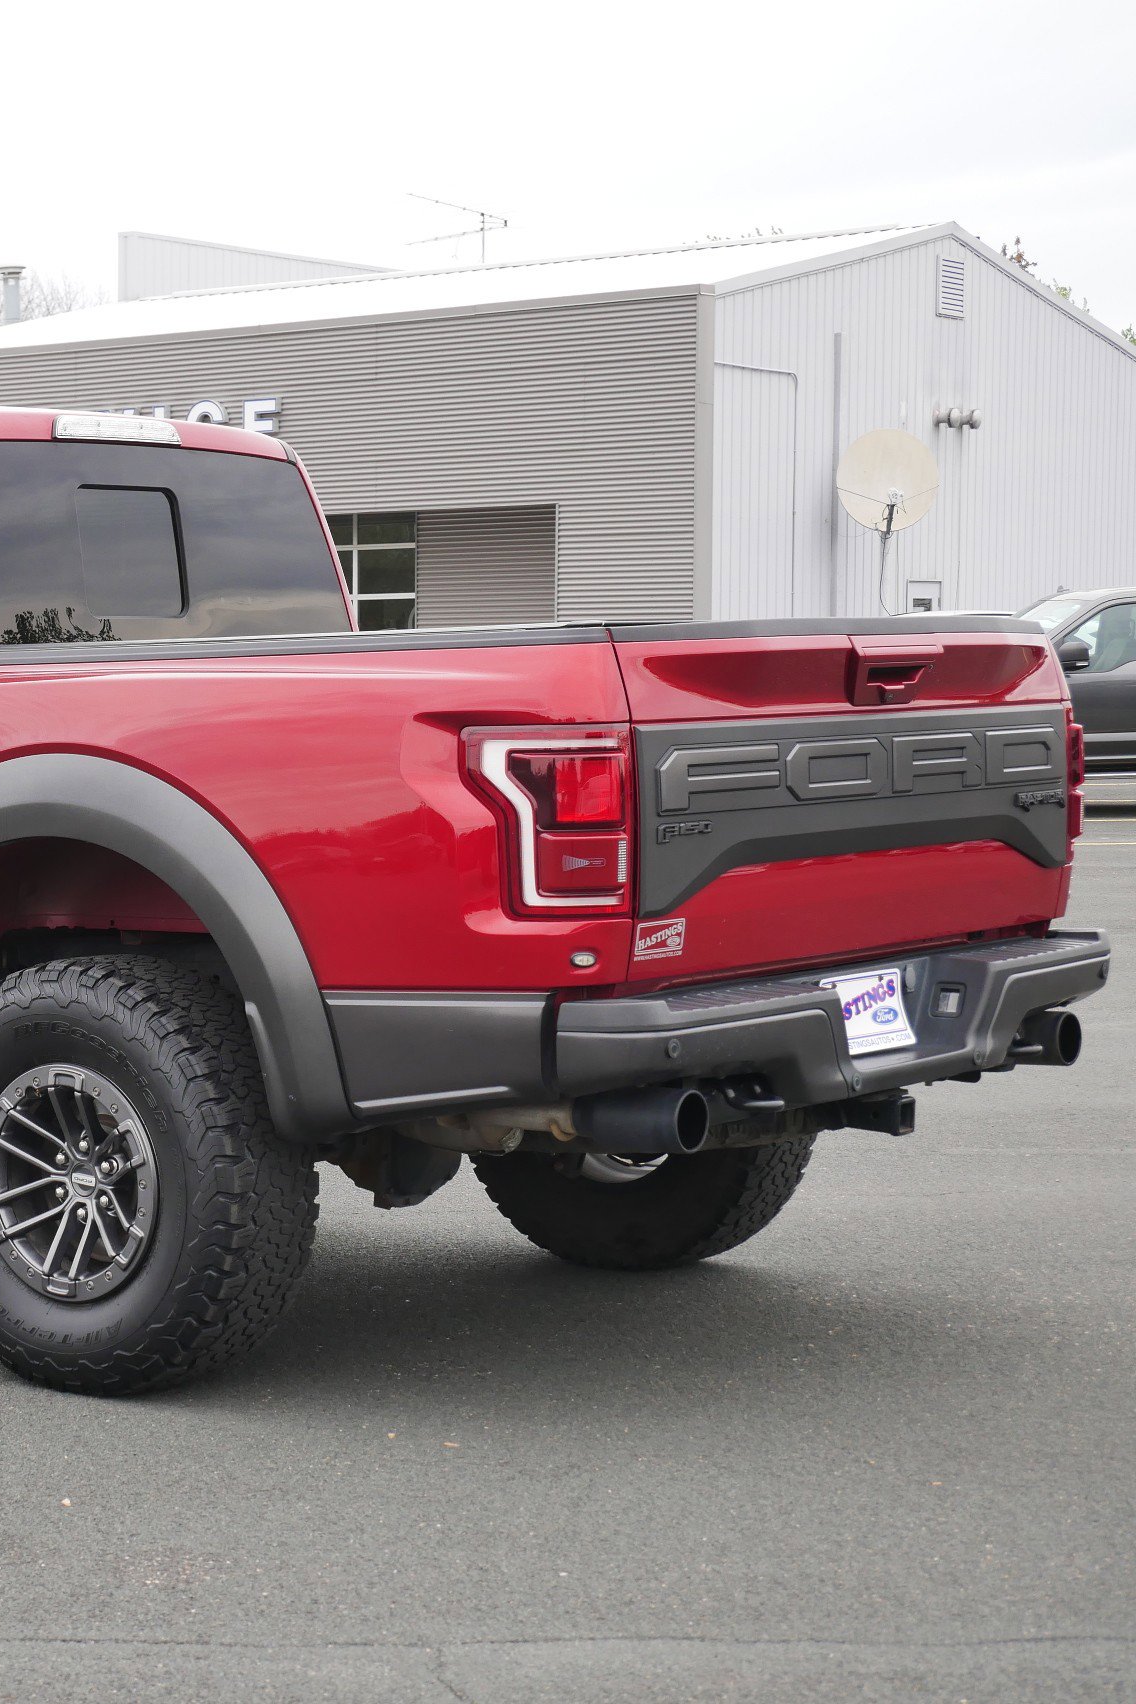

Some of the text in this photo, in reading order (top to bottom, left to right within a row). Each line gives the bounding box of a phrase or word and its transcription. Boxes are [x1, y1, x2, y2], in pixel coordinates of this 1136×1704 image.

[655, 724, 1063, 817] FORD
[1014, 789, 1065, 812] RAPTOR
[638, 922, 683, 950] HASTINGS
[876, 1008, 895, 1022] Ford
[73, 1176, 93, 1184] FORD
